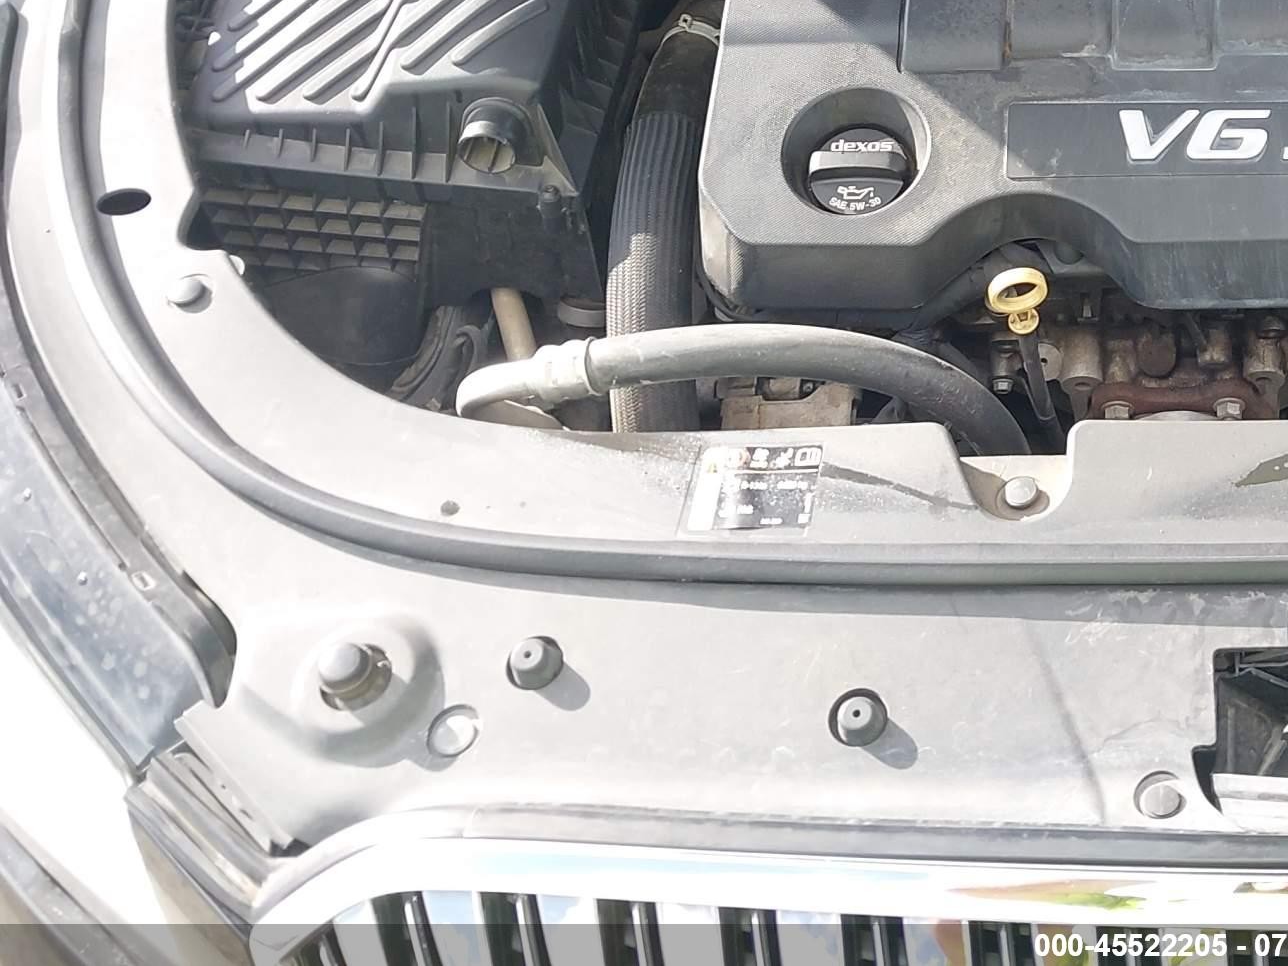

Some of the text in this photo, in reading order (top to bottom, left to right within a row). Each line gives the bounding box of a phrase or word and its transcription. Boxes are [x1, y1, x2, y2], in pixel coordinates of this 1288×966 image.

[1119, 109, 1272, 161] V6
[831, 139, 894, 152] dexos
[829, 197, 848, 210] SAE
